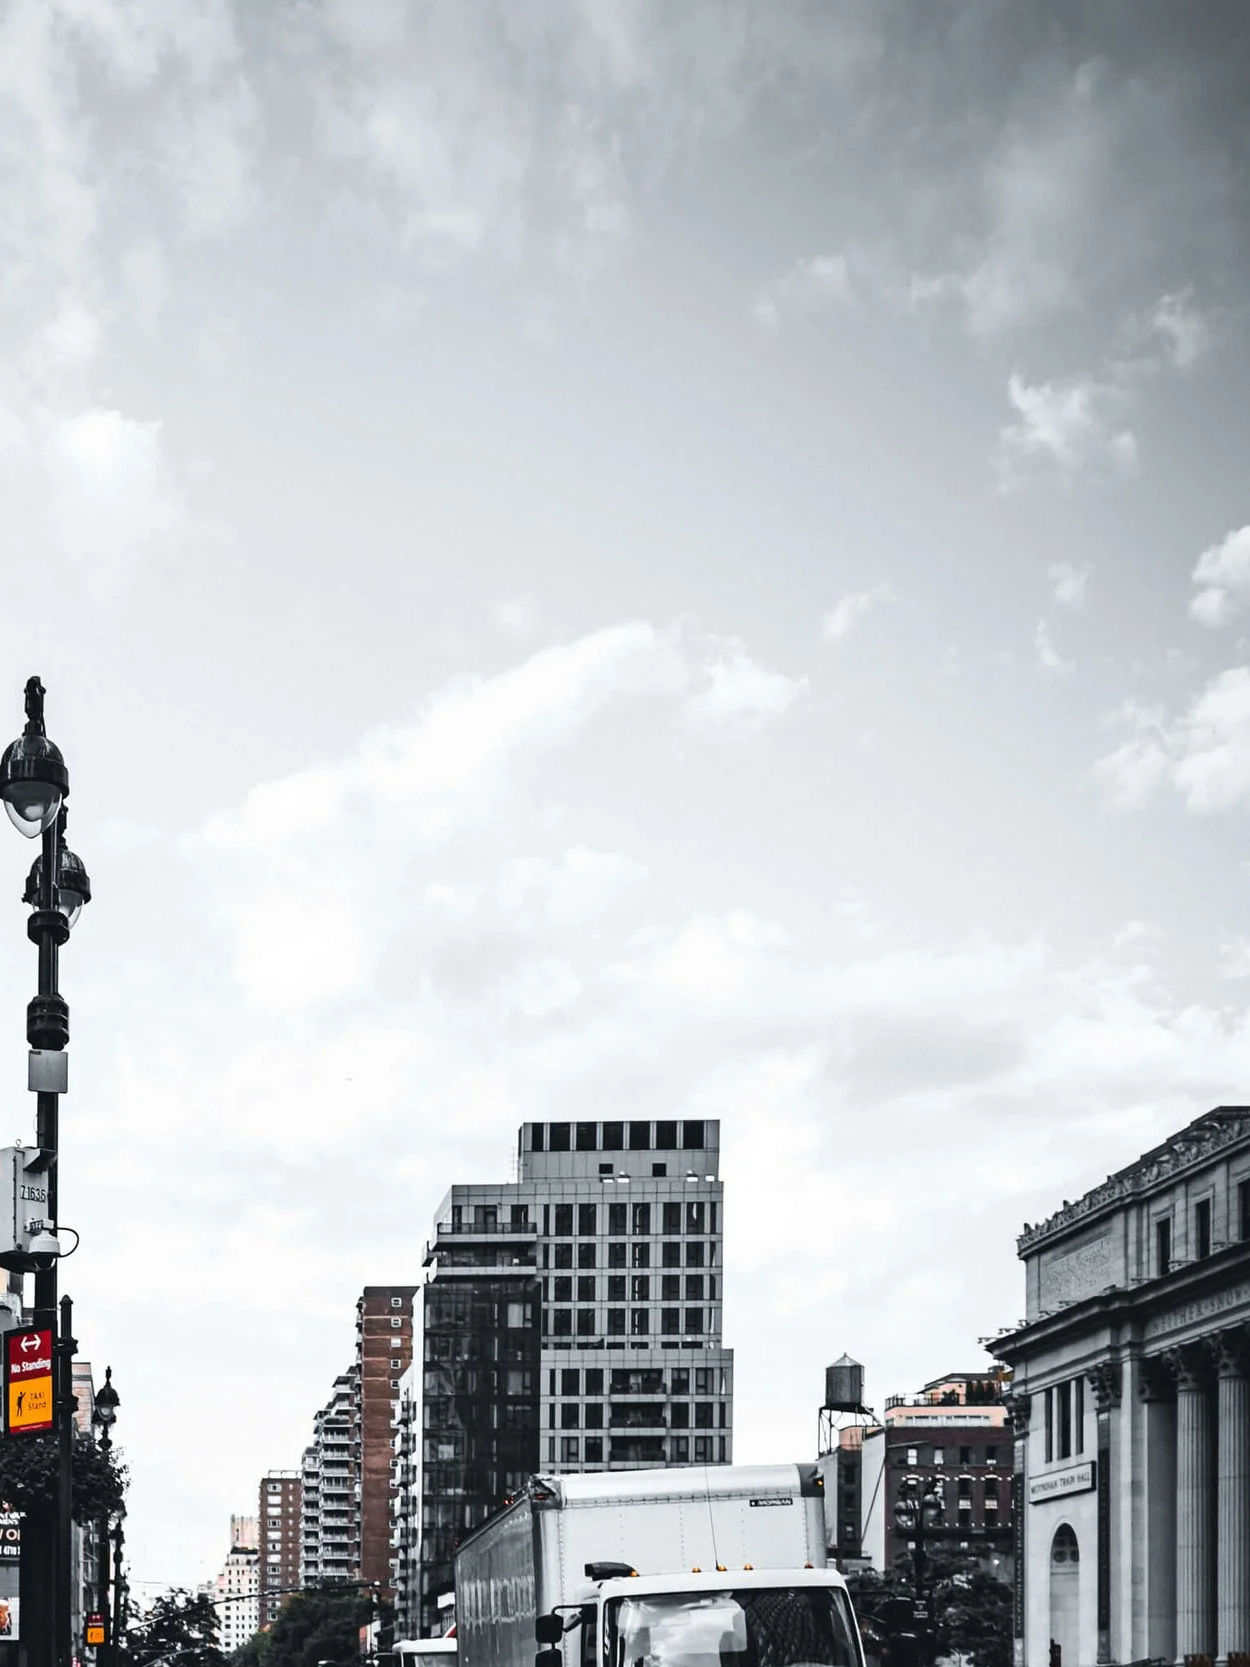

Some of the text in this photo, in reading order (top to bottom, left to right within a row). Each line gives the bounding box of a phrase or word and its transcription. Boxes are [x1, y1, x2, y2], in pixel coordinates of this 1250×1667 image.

[11, 1358, 51, 1374] No Standing
[28, 1401, 47, 1411] Stand
